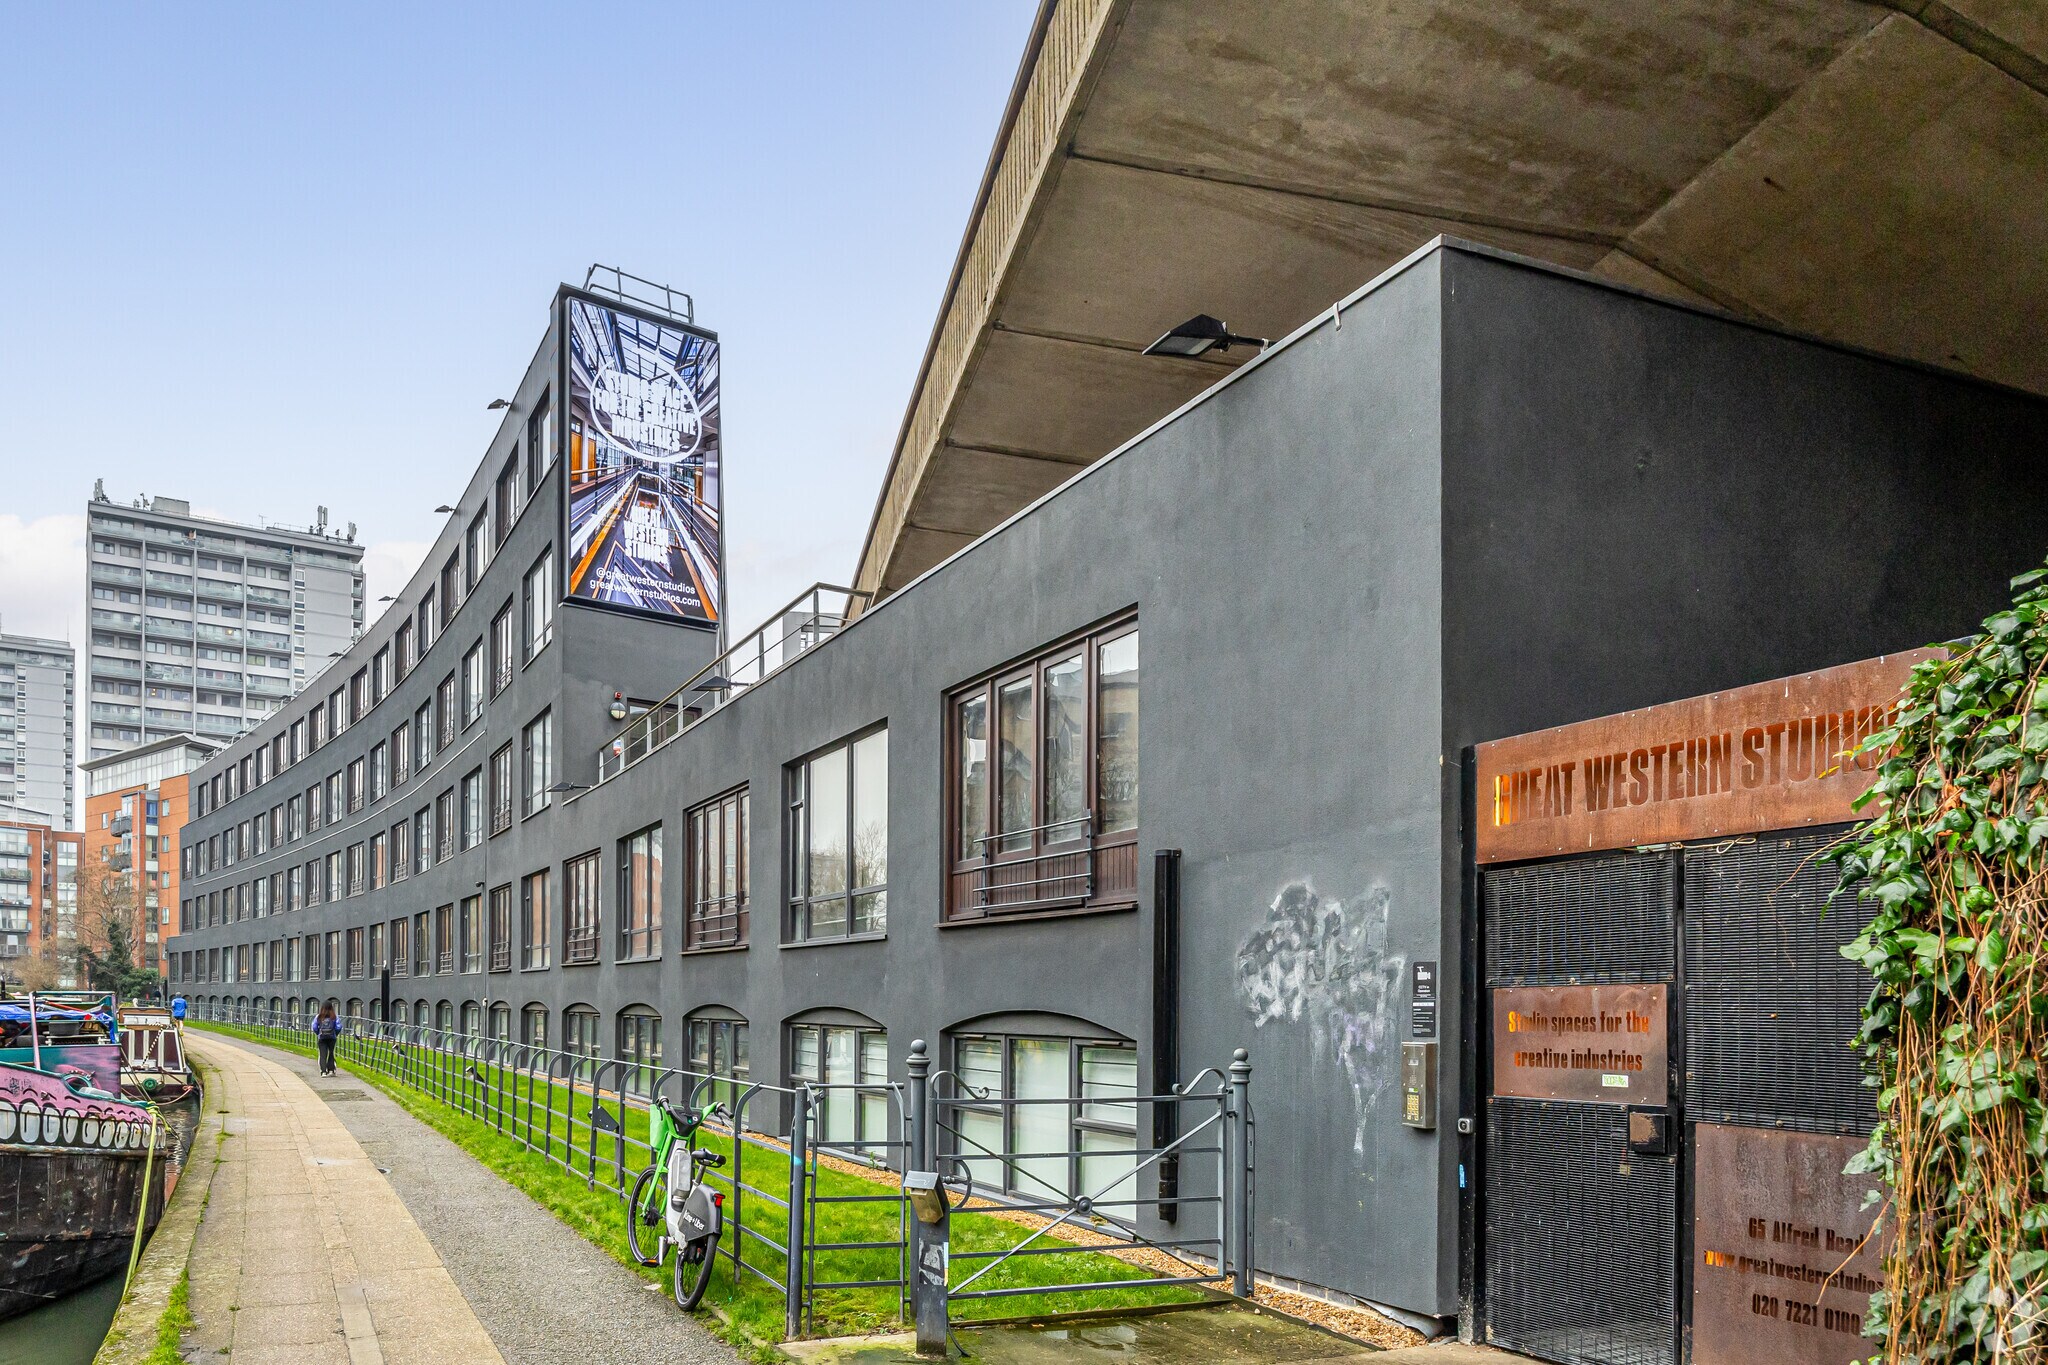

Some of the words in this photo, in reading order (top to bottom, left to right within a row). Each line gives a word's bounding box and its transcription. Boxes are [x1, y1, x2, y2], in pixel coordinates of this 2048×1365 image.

[630, 506, 661, 529] GREAT
[623, 520, 669, 546] WESTERN
[624, 538, 668, 566] STUDIOS
[590, 580, 701, 607] greatwesternstudios.com
[596, 567, 696, 595] @greatwesternstudios
[1494, 762, 1576, 827] GREAT
[1583, 732, 1732, 813] WESTERN
[1508, 1011, 1548, 1033] Studio
[1552, 1015, 1597, 1037] spaces
[1600, 1011, 1622, 1033] for
[1626, 1010, 1649, 1033] the
[1514, 1048, 1568, 1069] creative
[1571, 1048, 1643, 1072] industries
[1749, 1217, 1766, 1240] 65
[1773, 1221, 1819, 1249] Alfred
[1752, 1293, 1779, 1319] 020
[1785, 1300, 1818, 1327] 7221
[1824, 1308, 1860, 1336] 0100
